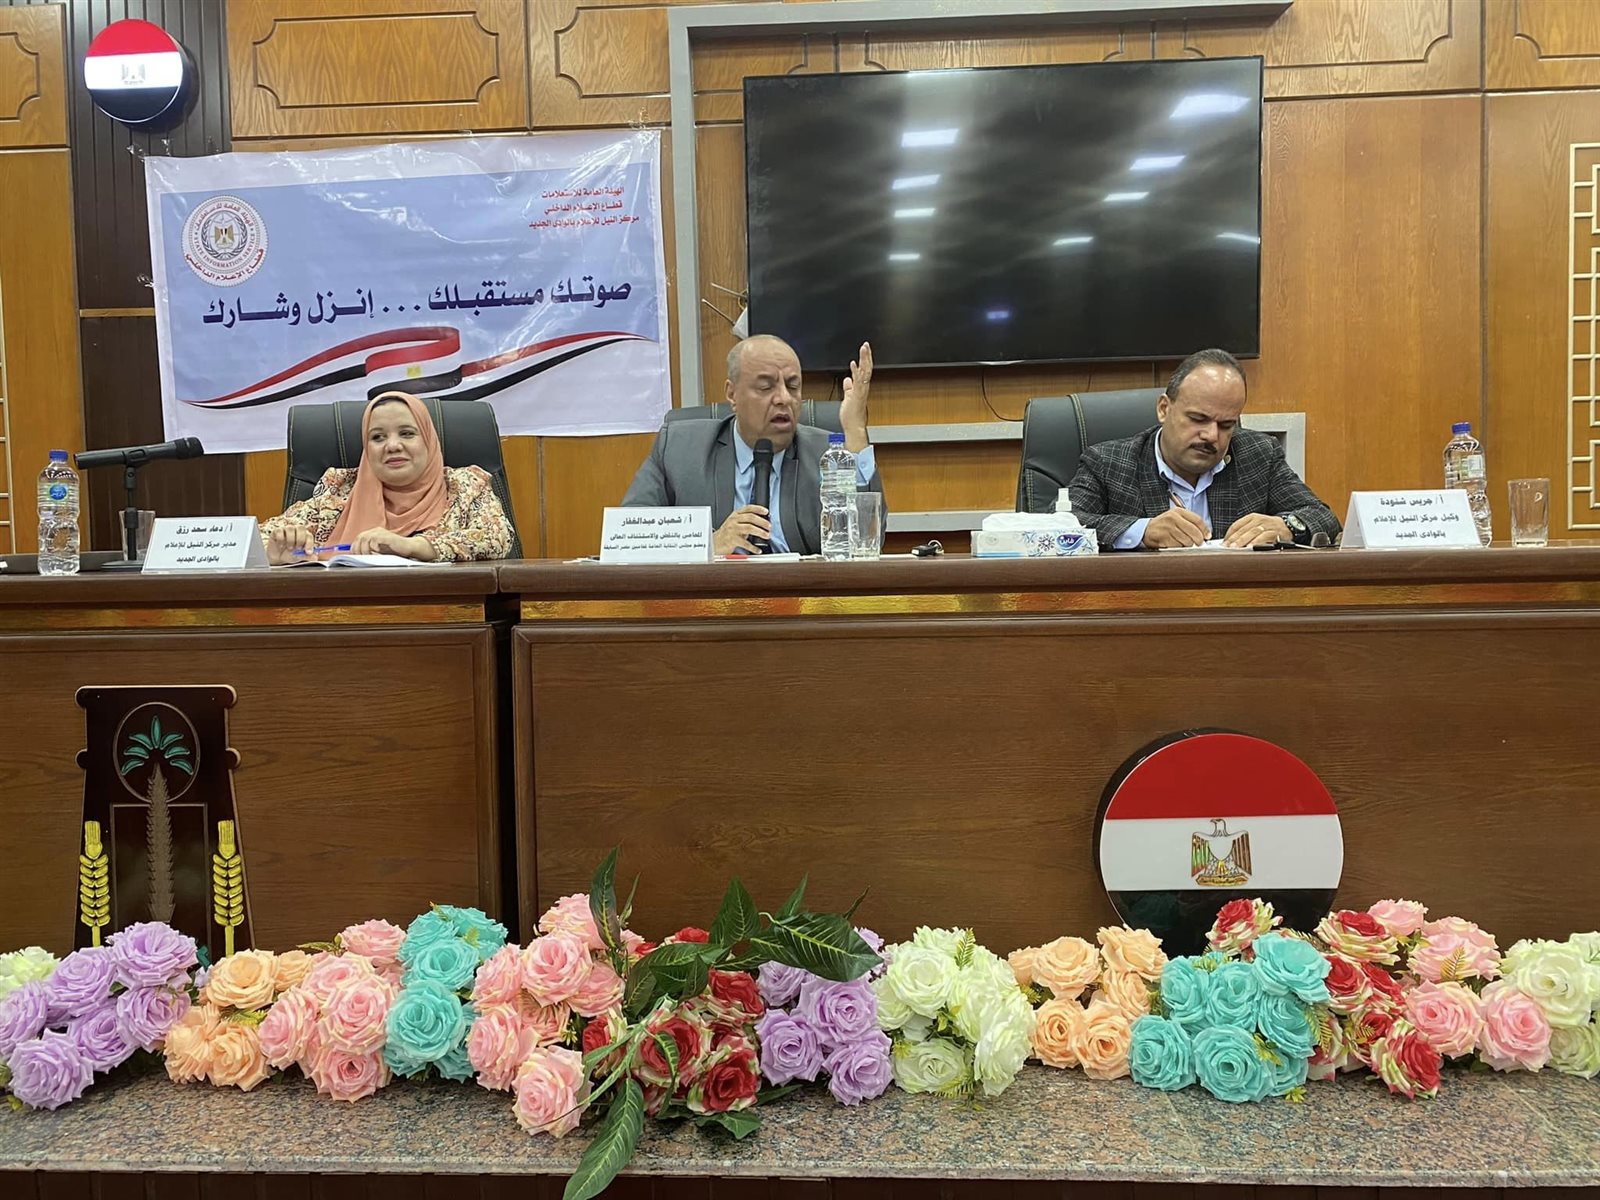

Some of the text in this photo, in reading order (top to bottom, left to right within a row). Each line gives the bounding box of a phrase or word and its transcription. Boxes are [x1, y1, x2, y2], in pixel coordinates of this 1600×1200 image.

[583, 188, 603, 196] العامة
[602, 200, 623, 211] قطاع
[601, 216, 618, 226] النيل
[618, 214, 640, 225] مركز
[528, 220, 552, 230] الجديد
[203, 254, 242, 268] INFORMATION
[242, 233, 256, 260] SERVICE
[245, 248, 264, 274] قطاع
[551, 275, 632, 308] صوتك
[428, 280, 544, 317] مستقبلك
[203, 292, 301, 329] وشارك
[307, 288, 375, 325] إنزل
[657, 516, 682, 526] شعبان
[1399, 514, 1419, 523] النيل
[1420, 514, 1438, 523] مركز
[176, 525, 190, 535] رزق
[1395, 531, 1417, 540] الجديد
[186, 541, 204, 549] النيل
[205, 541, 220, 549] مركز
[221, 541, 237, 549] مدير
[176, 555, 196, 563] الجديد
